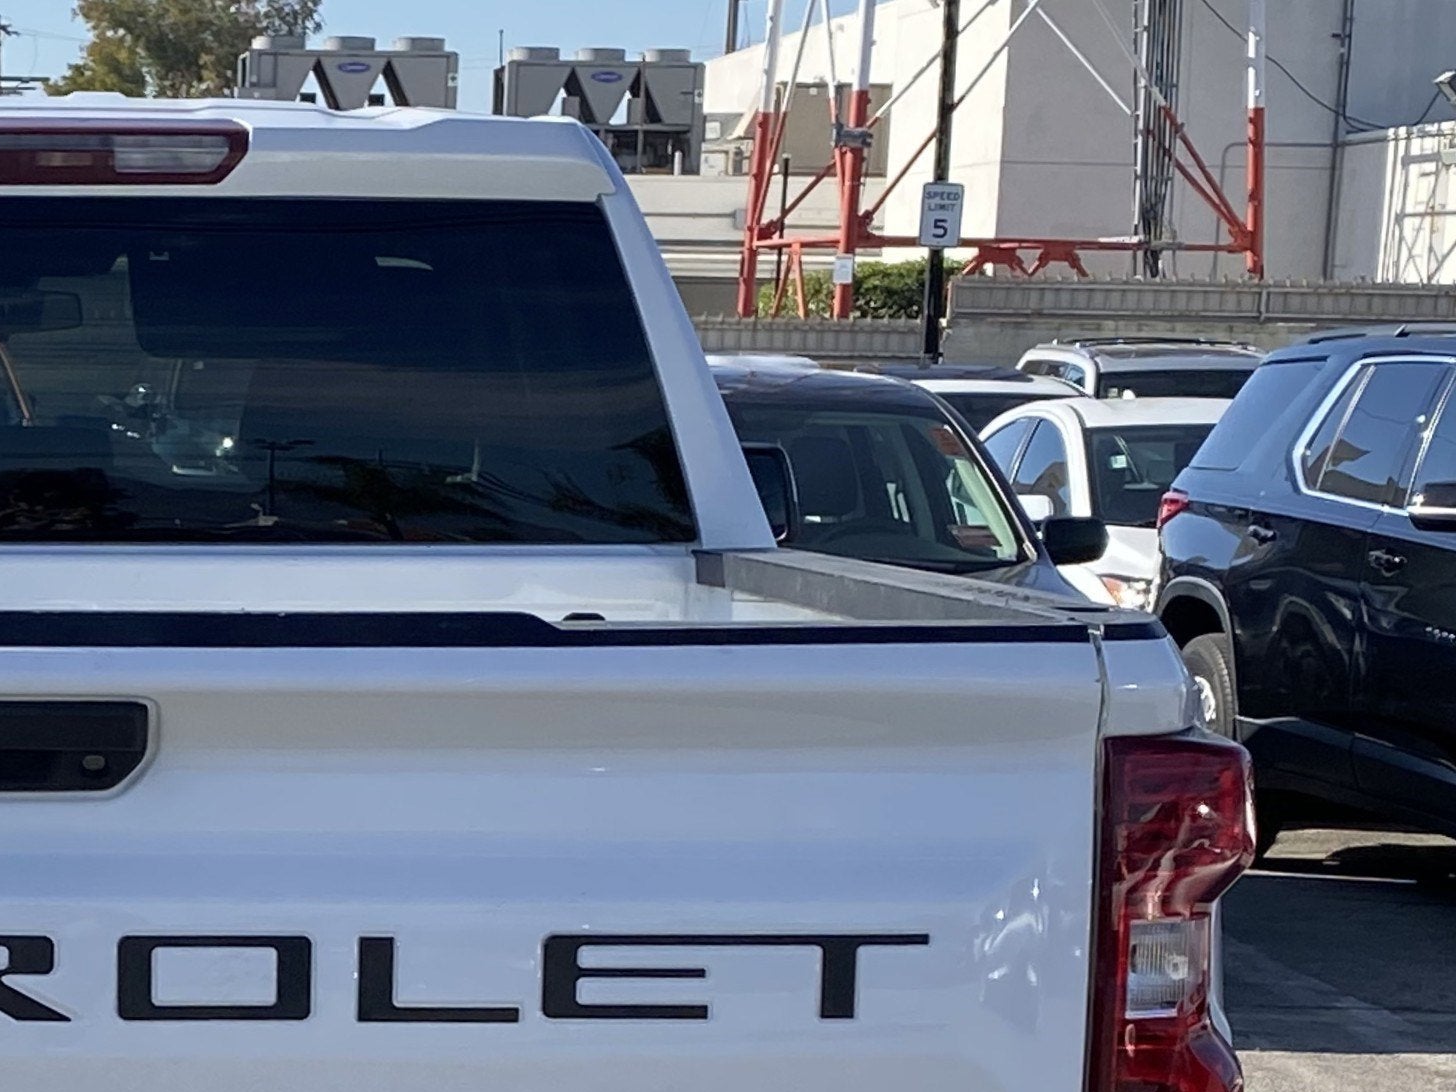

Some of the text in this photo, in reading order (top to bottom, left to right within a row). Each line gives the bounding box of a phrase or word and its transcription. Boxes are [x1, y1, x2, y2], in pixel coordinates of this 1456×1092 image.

[925, 191, 961, 201] SPEED
[928, 203, 956, 213] LIMIT
[932, 218, 948, 239] 5
